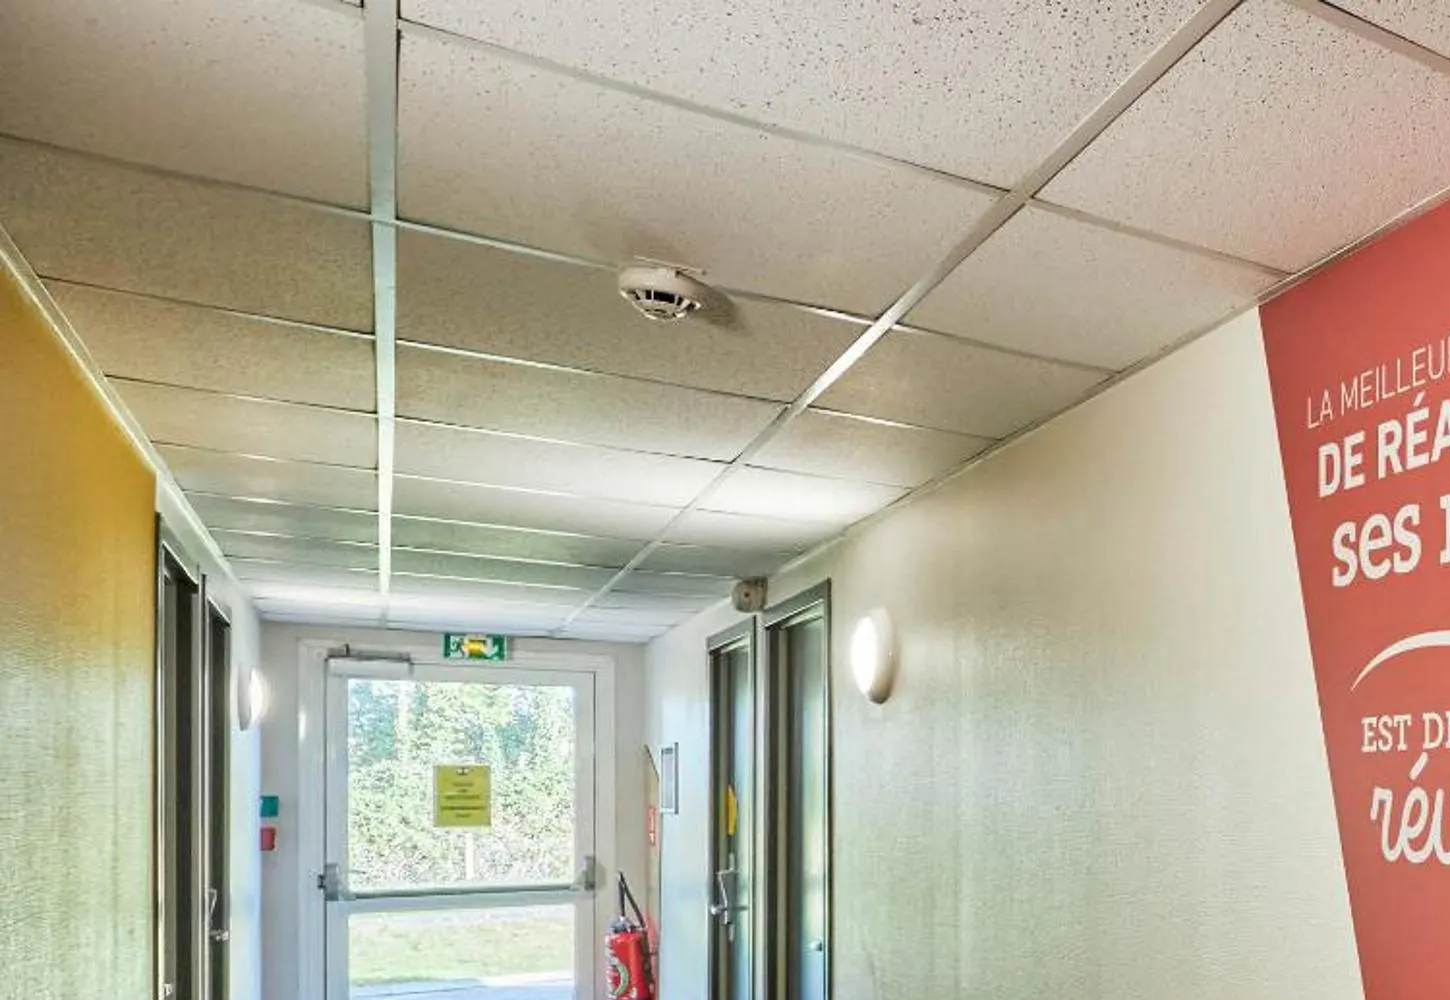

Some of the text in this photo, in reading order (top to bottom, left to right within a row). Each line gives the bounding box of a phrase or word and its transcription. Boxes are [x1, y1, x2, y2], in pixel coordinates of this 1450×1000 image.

[1307, 391, 1334, 429] LA
[1317, 430, 1366, 498] DE
[1331, 503, 1422, 588] ses
[1360, 712, 1413, 753] EST
